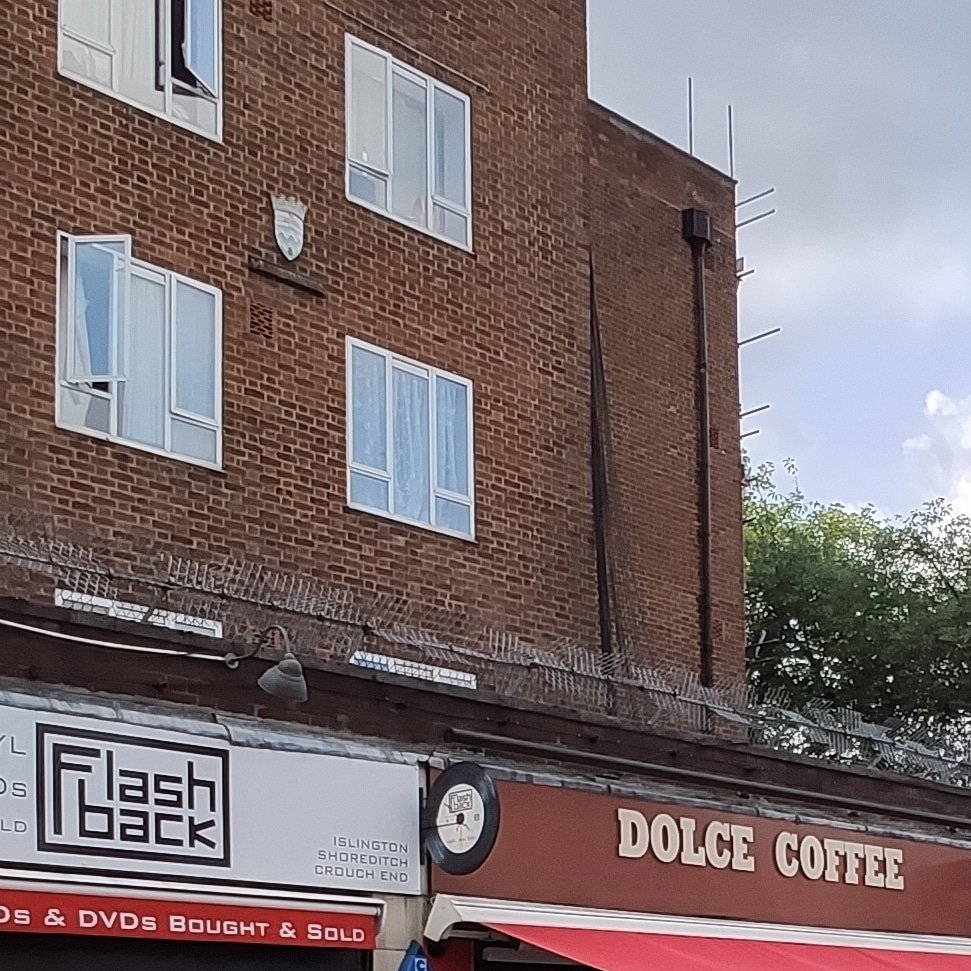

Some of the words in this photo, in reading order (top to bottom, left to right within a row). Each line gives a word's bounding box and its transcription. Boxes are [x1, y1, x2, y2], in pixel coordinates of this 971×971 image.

[52, 743, 216, 835] Flash
[79, 779, 216, 850] back
[317, 850, 409, 868] SHOREDITCH
[333, 836, 409, 853] ISLINGTON
[618, 807, 755, 872] DOLCE
[775, 831, 904, 890] COFFEE
[314, 865, 375, 880] CROUCH
[380, 870, 409, 882] END
[44, 908, 66, 927] &
[280, 922, 297, 939] &
